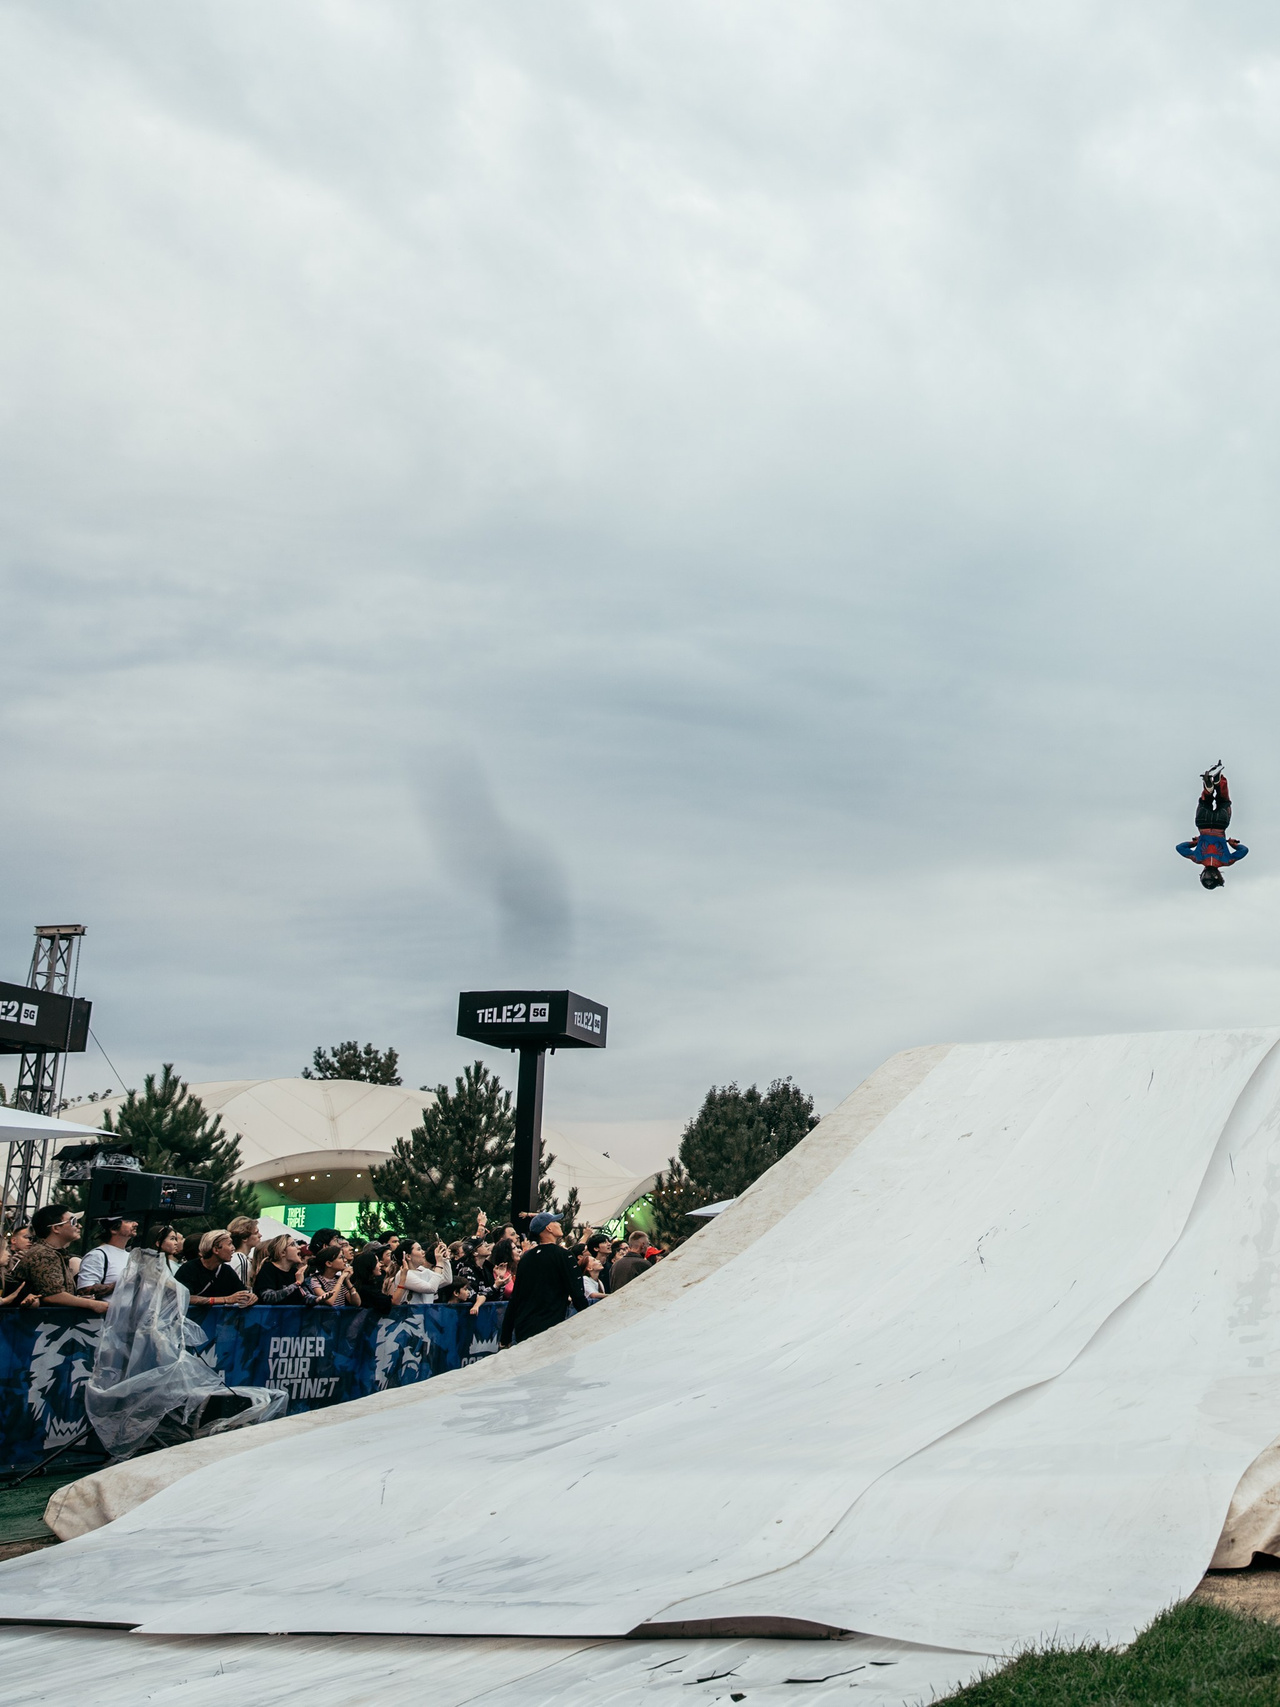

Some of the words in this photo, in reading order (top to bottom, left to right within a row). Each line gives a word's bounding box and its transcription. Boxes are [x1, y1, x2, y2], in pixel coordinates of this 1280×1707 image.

[23, 1009, 36, 1020] 5G
[476, 1002, 527, 1023] TELE2
[532, 1007, 547, 1018] 5G
[574, 1011, 593, 1031] TELE2
[286, 1217, 305, 1228] TRIPLE
[287, 1207, 306, 1218] TRIPLE
[268, 1336, 326, 1358] POWER
[267, 1357, 311, 1379] YOUR
[265, 1376, 340, 1400] INSTINCT
